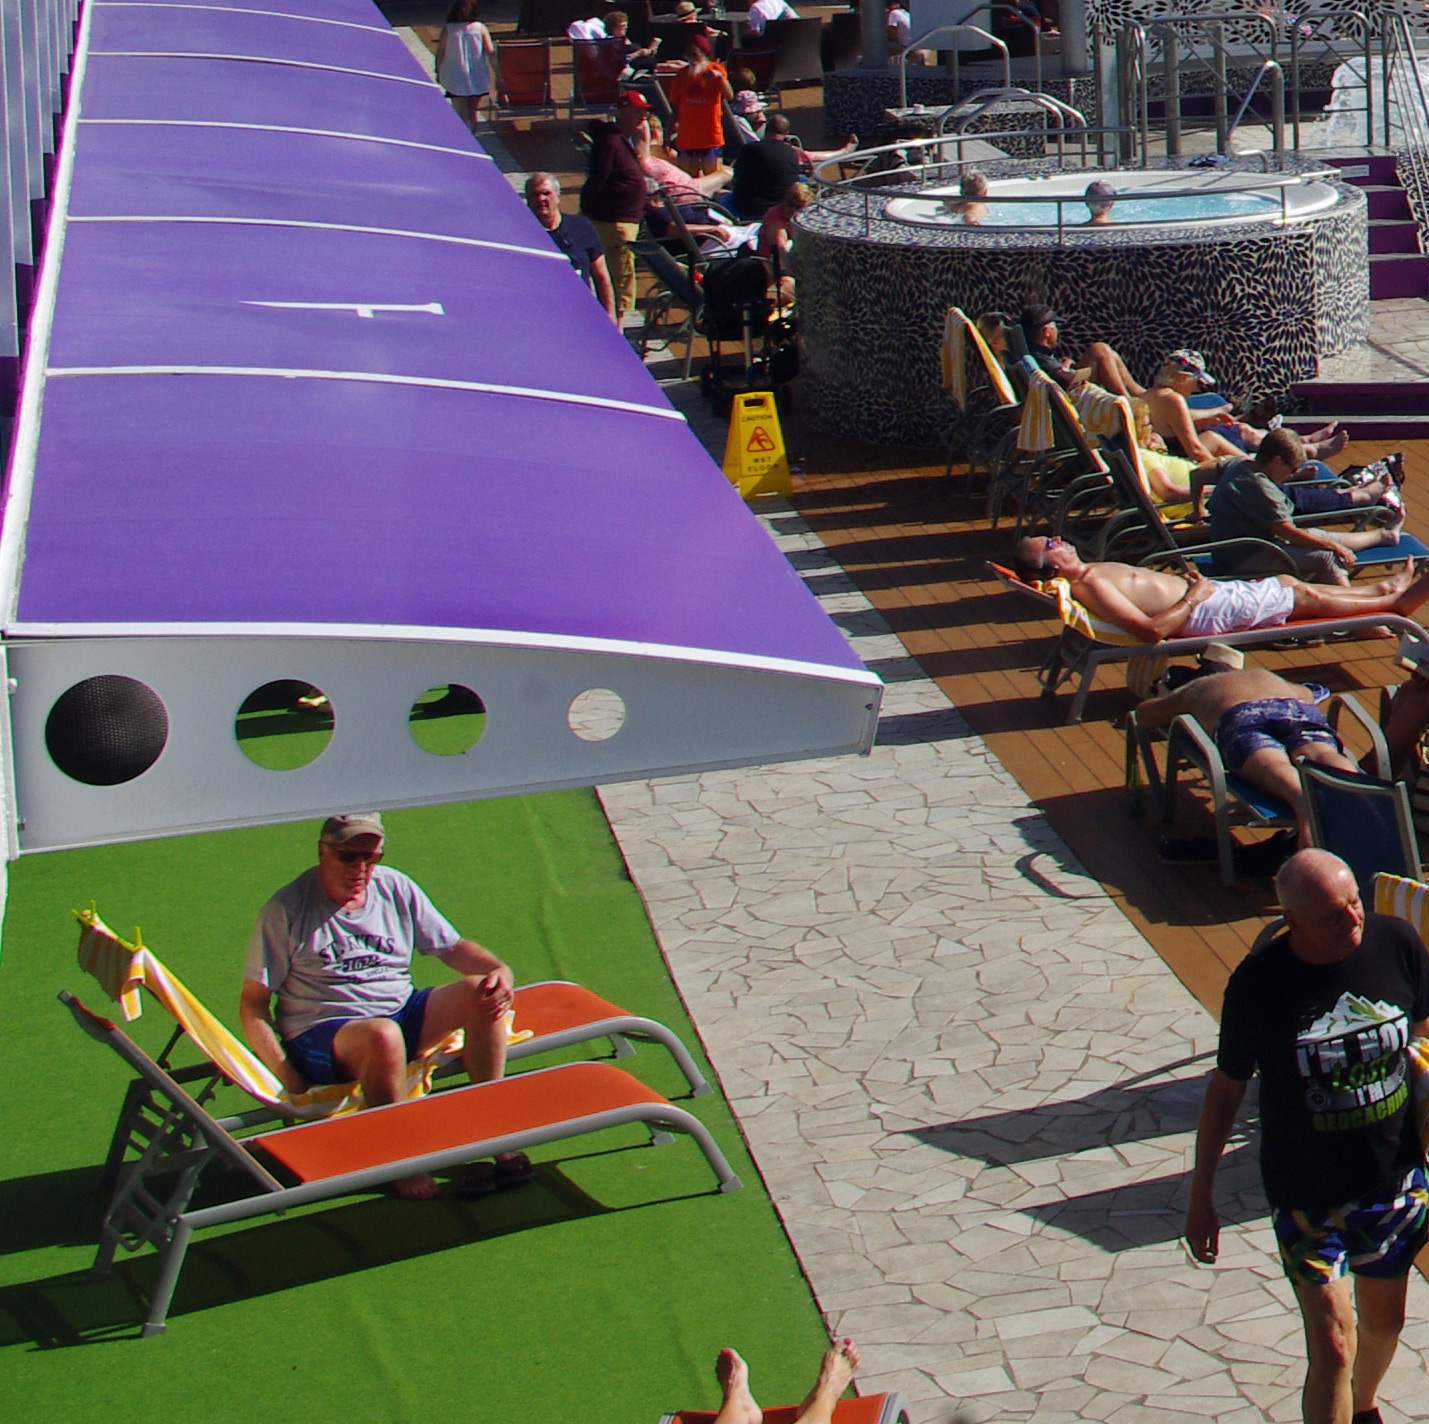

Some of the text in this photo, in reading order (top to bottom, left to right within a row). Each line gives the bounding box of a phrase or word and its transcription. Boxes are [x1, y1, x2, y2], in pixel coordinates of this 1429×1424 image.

[747, 463, 779, 472] FLOOR
[319, 940, 345, 966] ST.
[1296, 1015, 1409, 1077] I'M NOT
[1331, 1050, 1393, 1092] LOST
[1356, 1080, 1385, 1106] I'M
